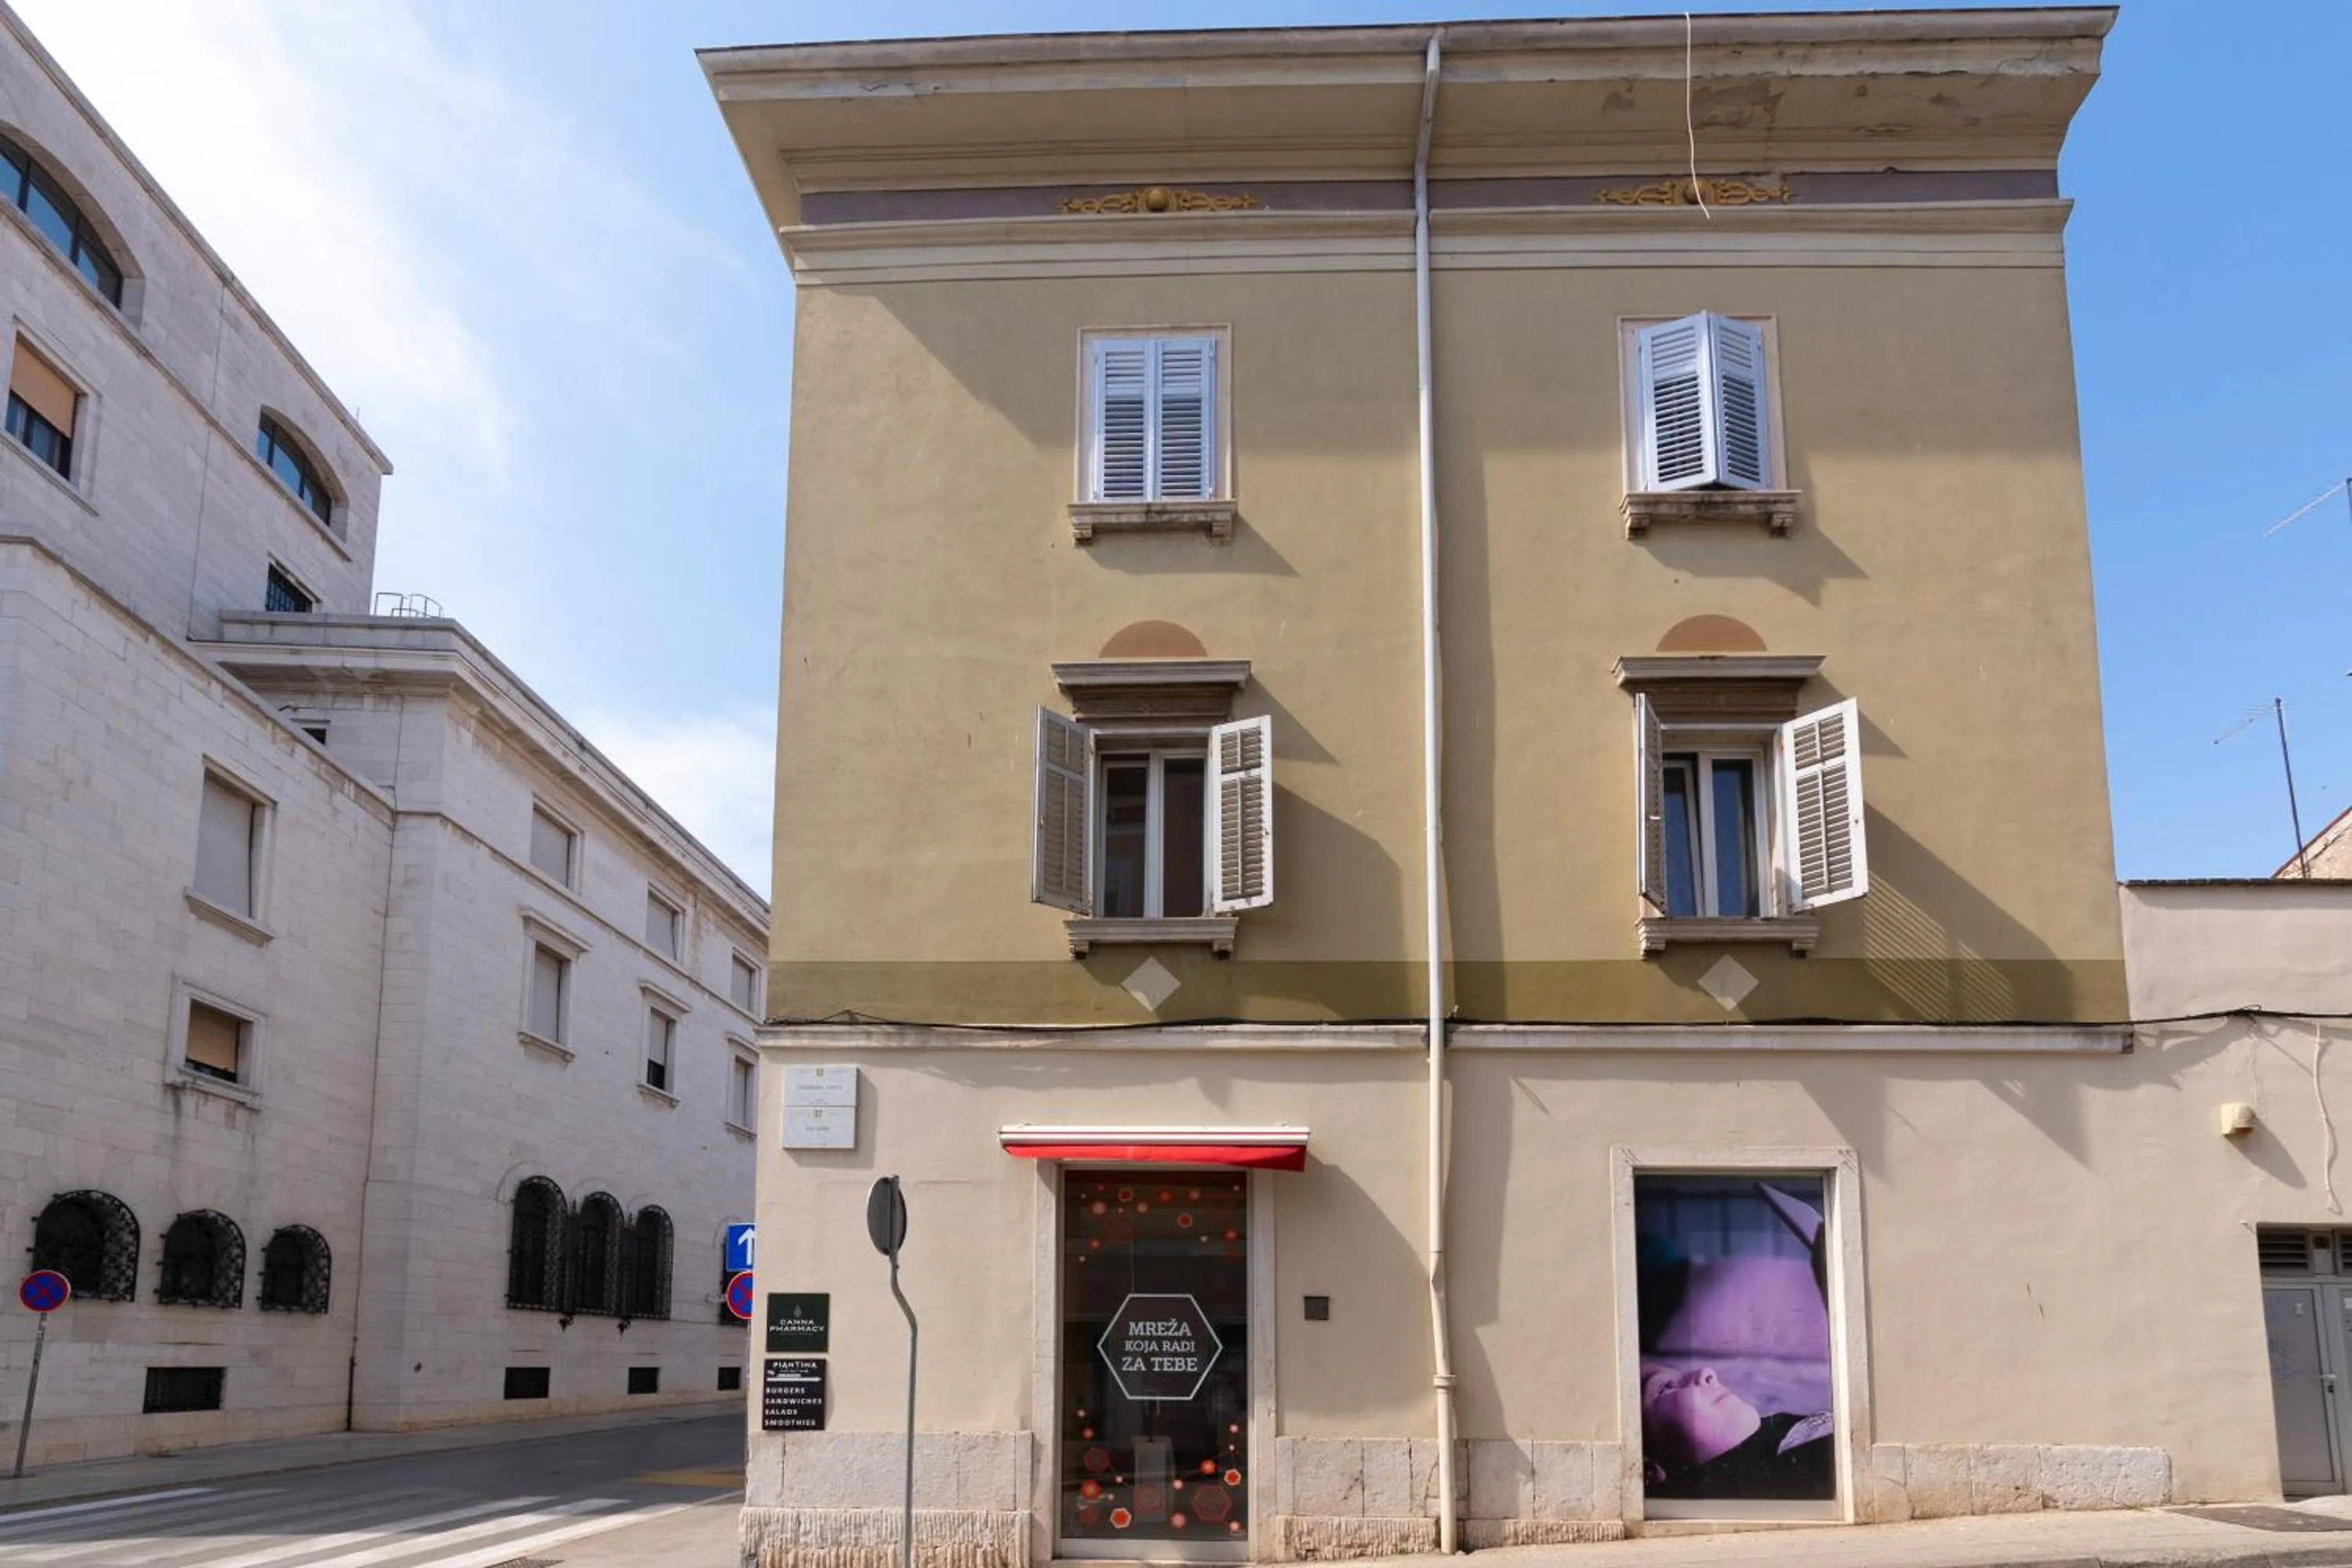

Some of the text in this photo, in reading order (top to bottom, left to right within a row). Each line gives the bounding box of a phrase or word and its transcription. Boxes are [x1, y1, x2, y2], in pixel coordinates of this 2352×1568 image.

[1129, 1317, 1192, 1336] MREŽA
[1124, 1340, 1196, 1353] KOJA RADI
[1122, 1357, 1197, 1371] ZA TEBE
